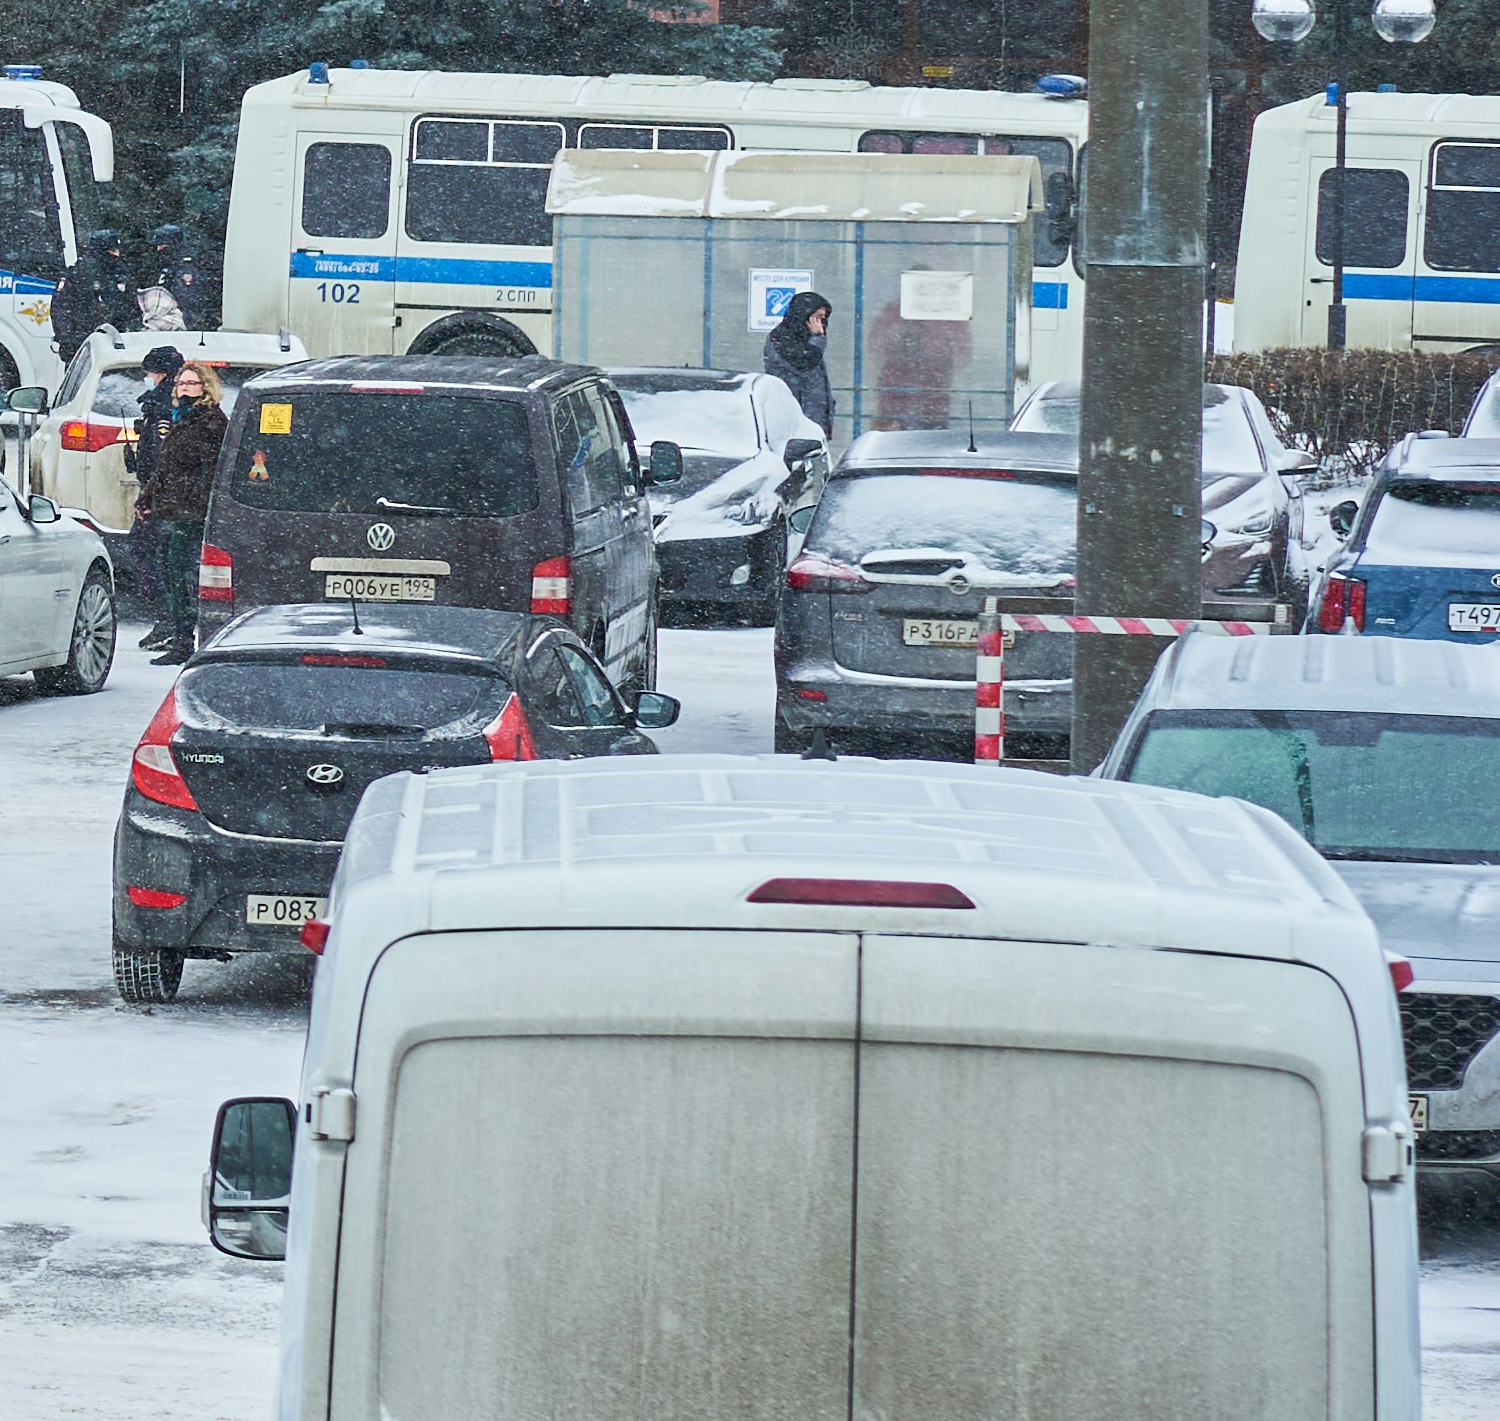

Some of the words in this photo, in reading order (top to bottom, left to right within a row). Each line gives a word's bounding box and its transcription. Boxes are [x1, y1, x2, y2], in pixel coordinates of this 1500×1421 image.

[317, 282, 361, 304] 102
[496, 290, 503, 301] 2
[332, 578, 400, 597] Р006УЕ
[181, 753, 225, 764] HYUNDAI
[257, 900, 317, 920] Р083
